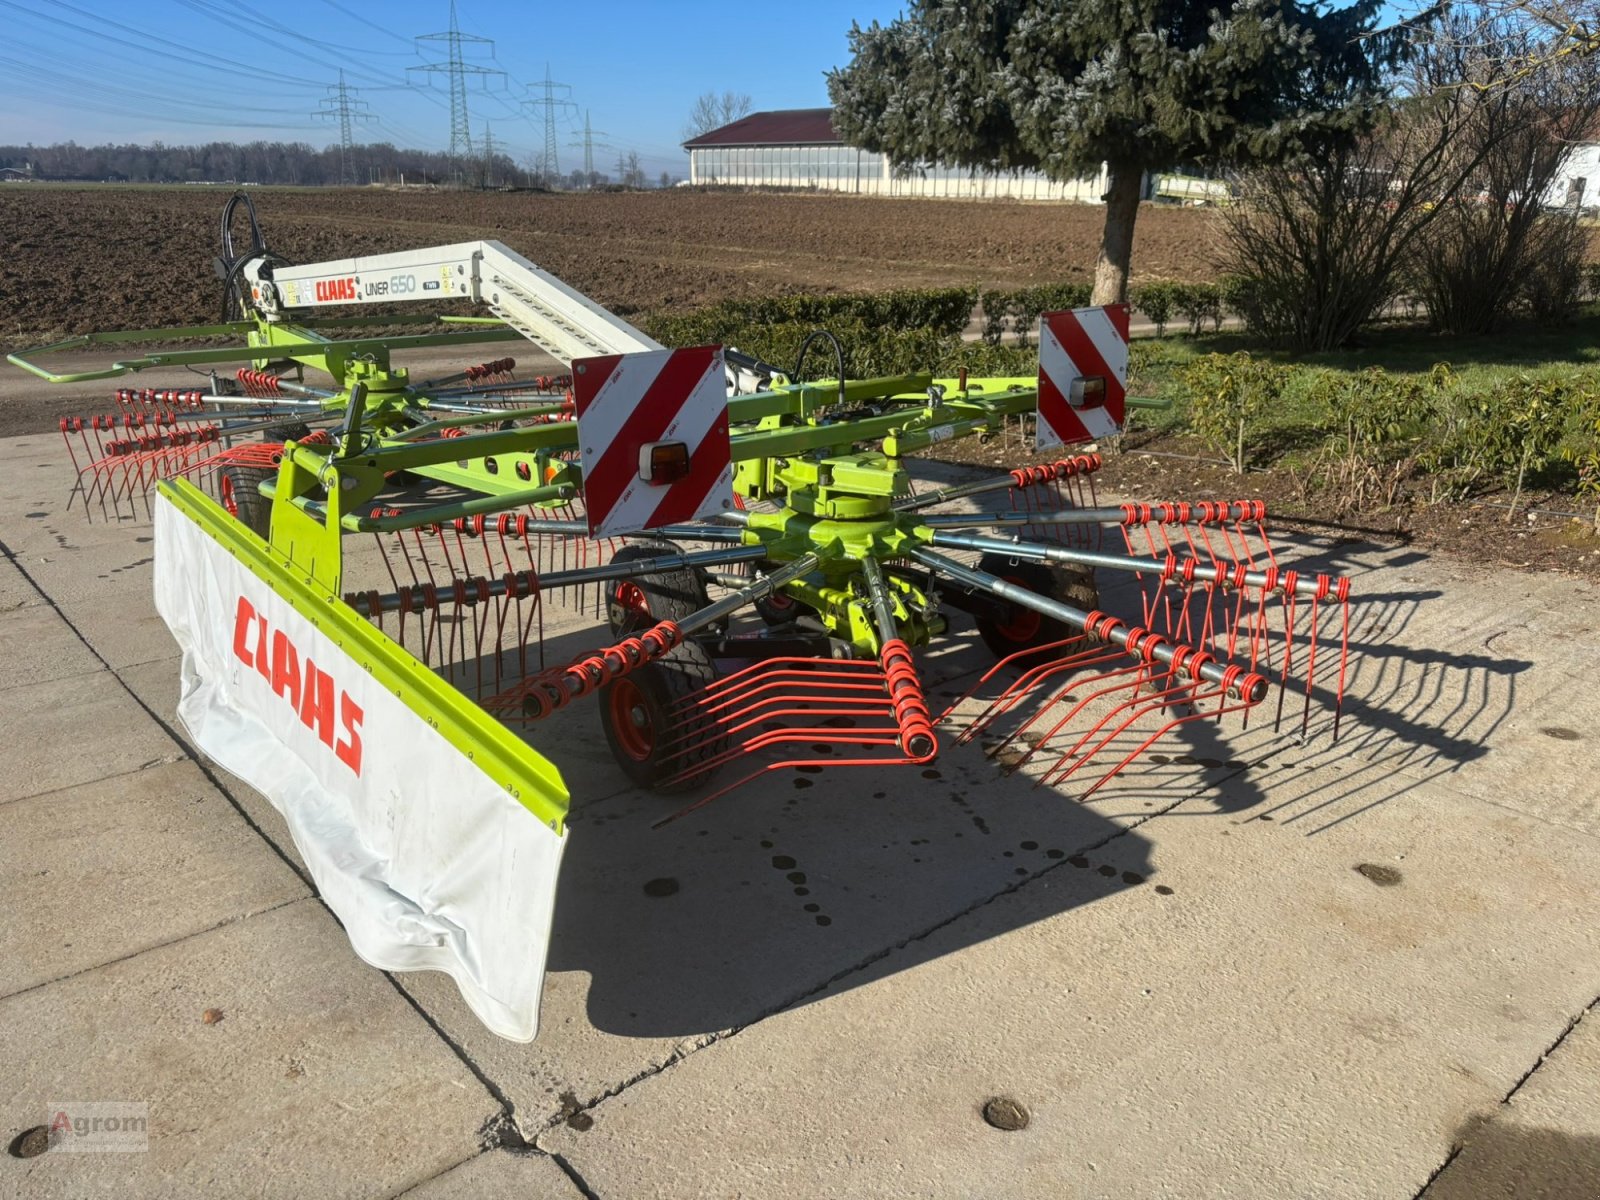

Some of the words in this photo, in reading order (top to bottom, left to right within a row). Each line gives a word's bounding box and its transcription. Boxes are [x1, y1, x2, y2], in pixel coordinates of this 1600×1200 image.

[315, 277, 355, 302] CLAAS
[365, 281, 389, 296] LINER
[390, 274, 416, 294] 650
[233, 595, 364, 779] CLAAS
